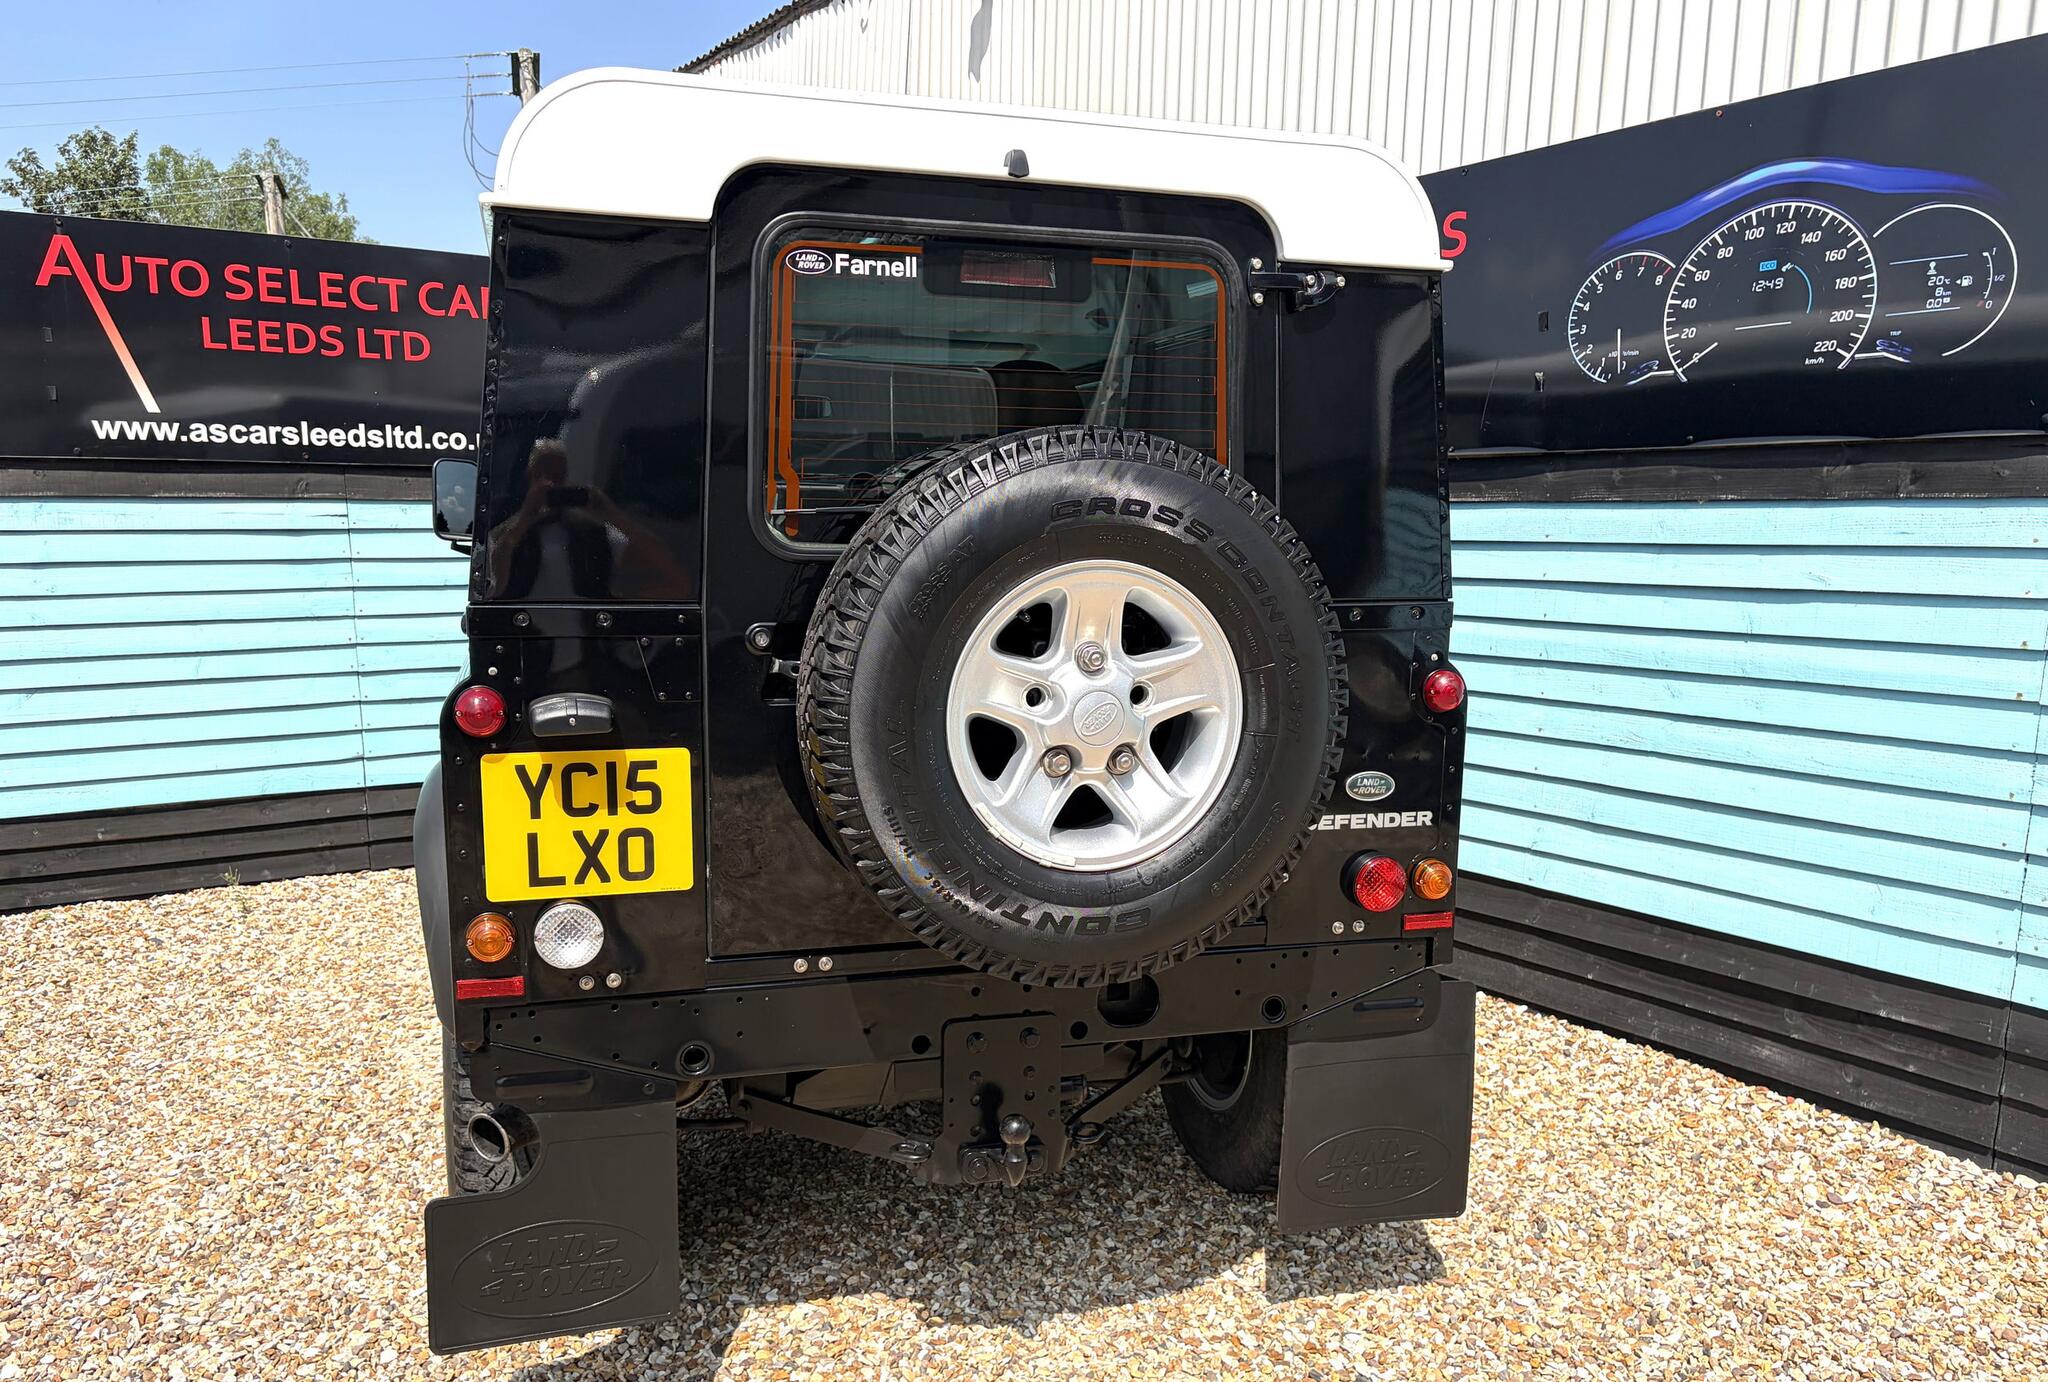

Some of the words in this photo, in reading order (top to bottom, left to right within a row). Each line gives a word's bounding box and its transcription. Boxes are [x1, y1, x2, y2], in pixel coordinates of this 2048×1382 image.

[1744, 226, 1765, 240] 100
[1776, 221, 1796, 235] 120
[1801, 230, 1821, 244] 140
[796, 253, 817, 262] LAND
[1717, 247, 1733, 259] 80
[1825, 248, 1847, 262] 160
[798, 261, 826, 270] ROVER
[835, 253, 917, 278] Farnell
[1761, 261, 1776, 270] ECO
[1615, 270, 1623, 281] 6
[1637, 267, 1645, 277] 7
[1694, 269, 1710, 282] 60
[1655, 275, 1663, 286] 8
[1834, 276, 1857, 290] 180
[224, 263, 407, 313] SELECT
[418, 281, 489, 319] CA
[1596, 284, 1603, 294] 5
[1583, 302, 1590, 311] 4
[1681, 298, 1697, 309] 40
[1985, 300, 1992, 309] 0
[1829, 310, 1853, 323] 200
[1580, 324, 1587, 334] 3
[1681, 327, 1697, 338] 20
[201, 316, 345, 357] LEEDS
[357, 327, 432, 362] LTD
[1586, 344, 1593, 354] 2
[1814, 340, 1837, 353] 220
[1601, 357, 1606, 367] 1
[1804, 356, 1824, 366] km/h
[1356, 778, 1381, 786] LAND
[514, 760, 662, 820] YC15
[1359, 786, 1386, 795] ROVER
[1308, 811, 1433, 831] EFENDER
[526, 827, 655, 888] LXO
[492, 1233, 596, 1273] LAND
[502, 1259, 632, 1303] ROVER
